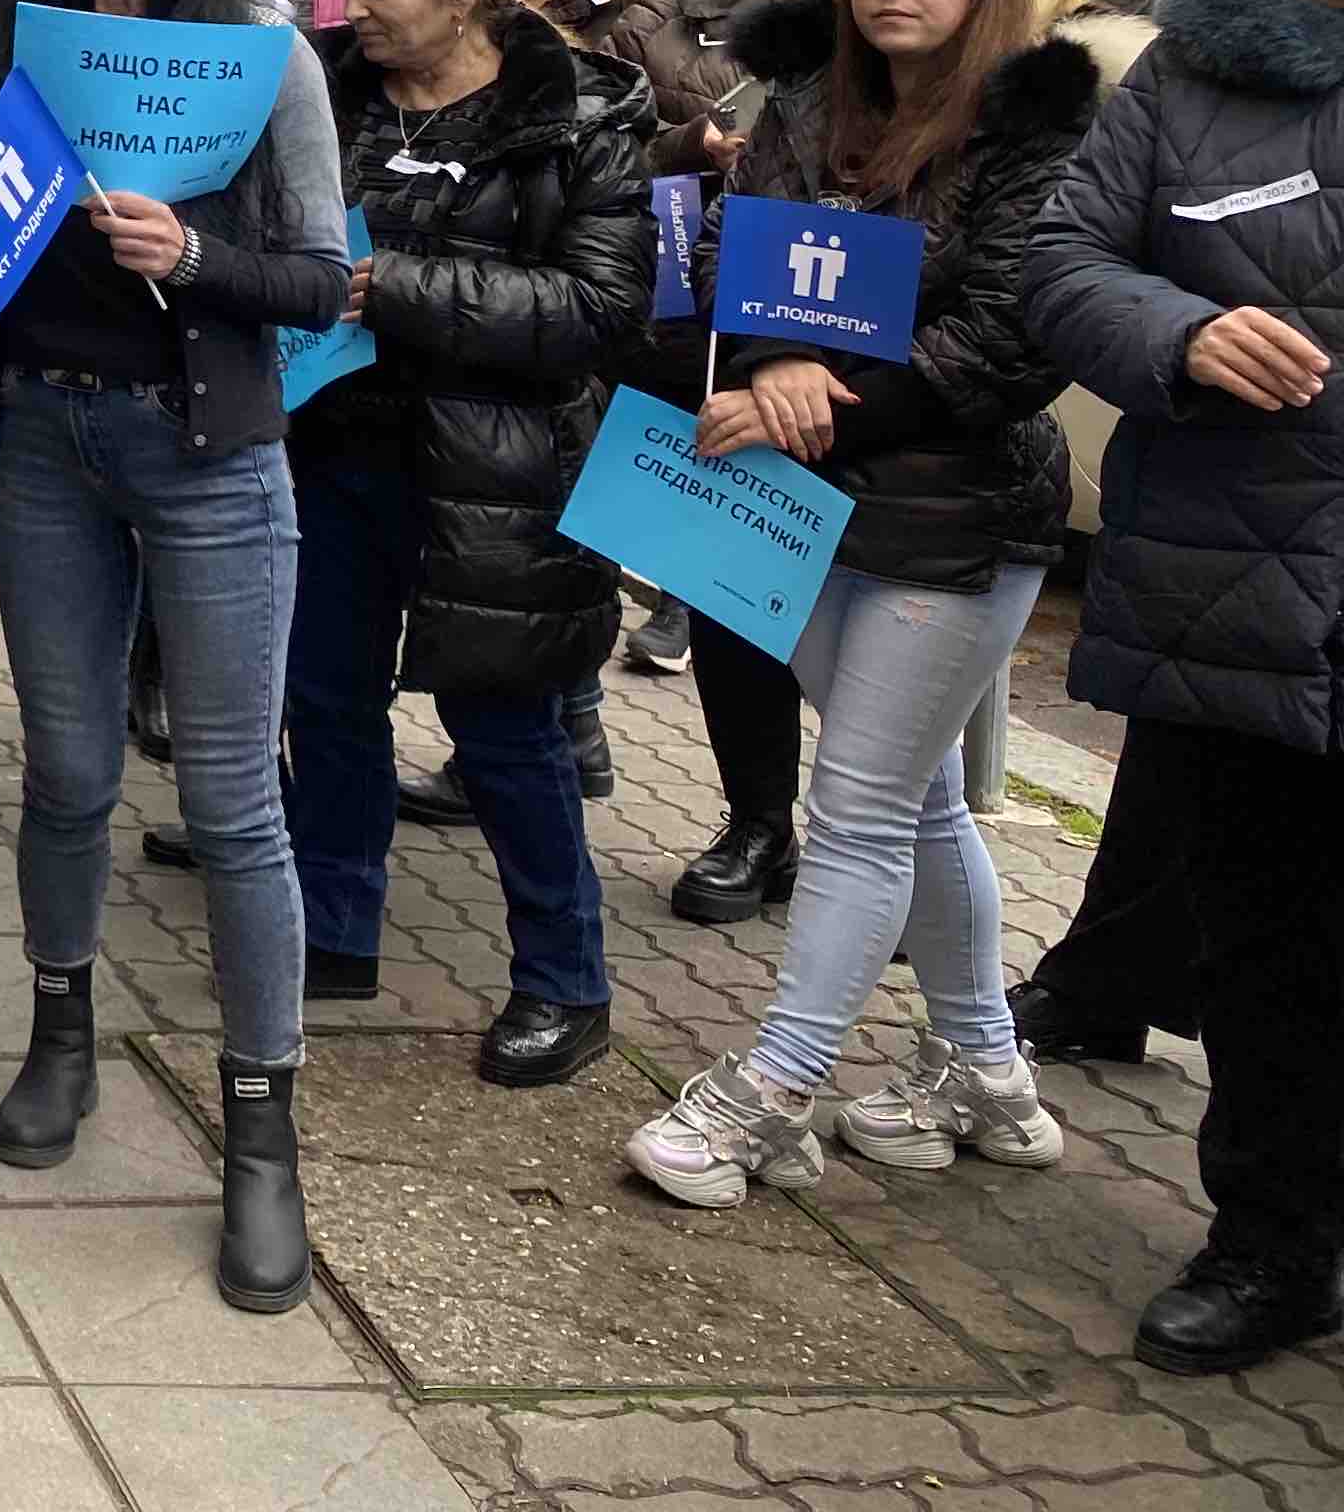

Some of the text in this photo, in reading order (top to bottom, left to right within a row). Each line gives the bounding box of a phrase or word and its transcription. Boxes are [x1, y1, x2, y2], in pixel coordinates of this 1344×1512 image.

[79, 49, 243, 81] ЗАЩО ВСЕ ЗА
[136, 94, 187, 116] НАС
[1264, 182, 1297, 200] 2025
[741, 300, 879, 335] КТ „ПОДКРЕПА“
[643, 426, 825, 534] СЛЕД ПРОТЕСТИТЕ
[633, 453, 811, 561] СЛЕДВАТ СТАЧКИ!
